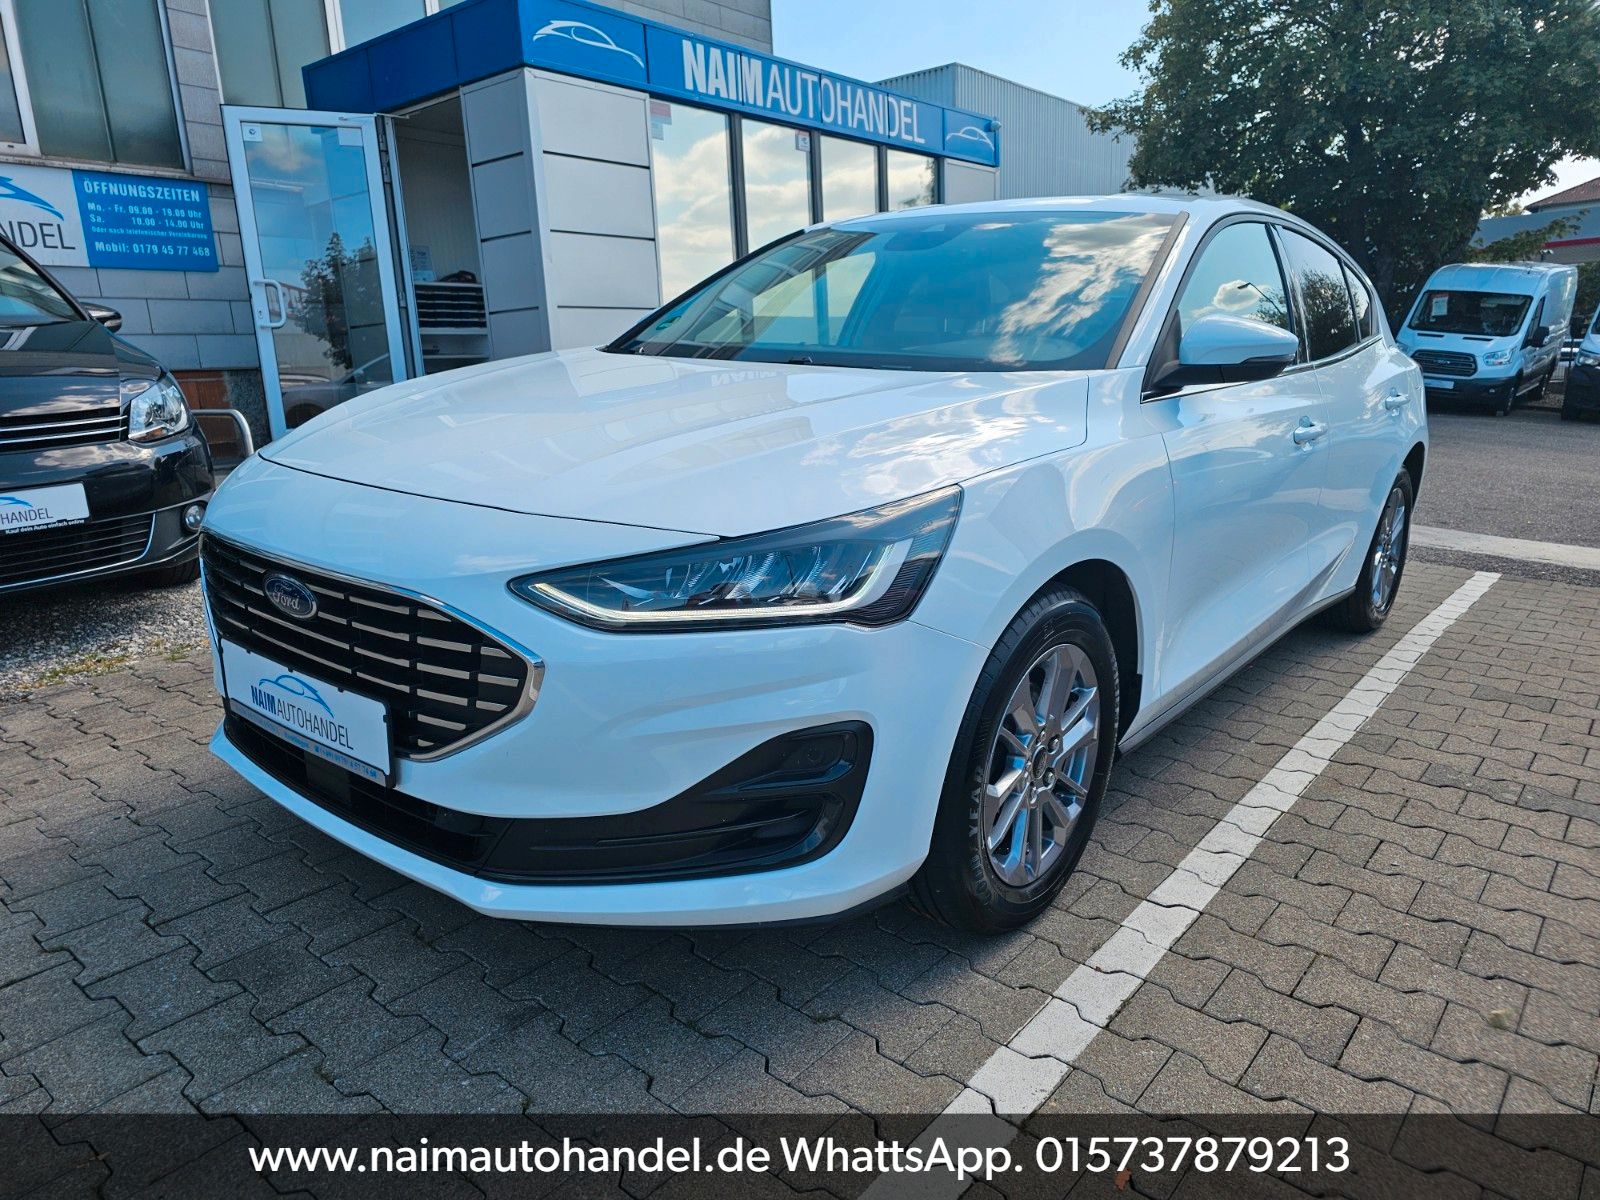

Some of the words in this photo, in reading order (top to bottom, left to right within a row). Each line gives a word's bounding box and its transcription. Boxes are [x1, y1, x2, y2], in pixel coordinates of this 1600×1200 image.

[83, 178, 200, 203] ÖFFNUNGSZEITEN
[87, 202, 105, 212] Mo.
[114, 204, 126, 214] Fr.
[188, 209, 202, 219] Uhr
[89, 214, 105, 223] Sa.
[190, 221, 204, 230] Uhr
[95, 241, 131, 254] Mobil:
[162, 245, 174, 256] 45
[177, 245, 189, 256] 77
